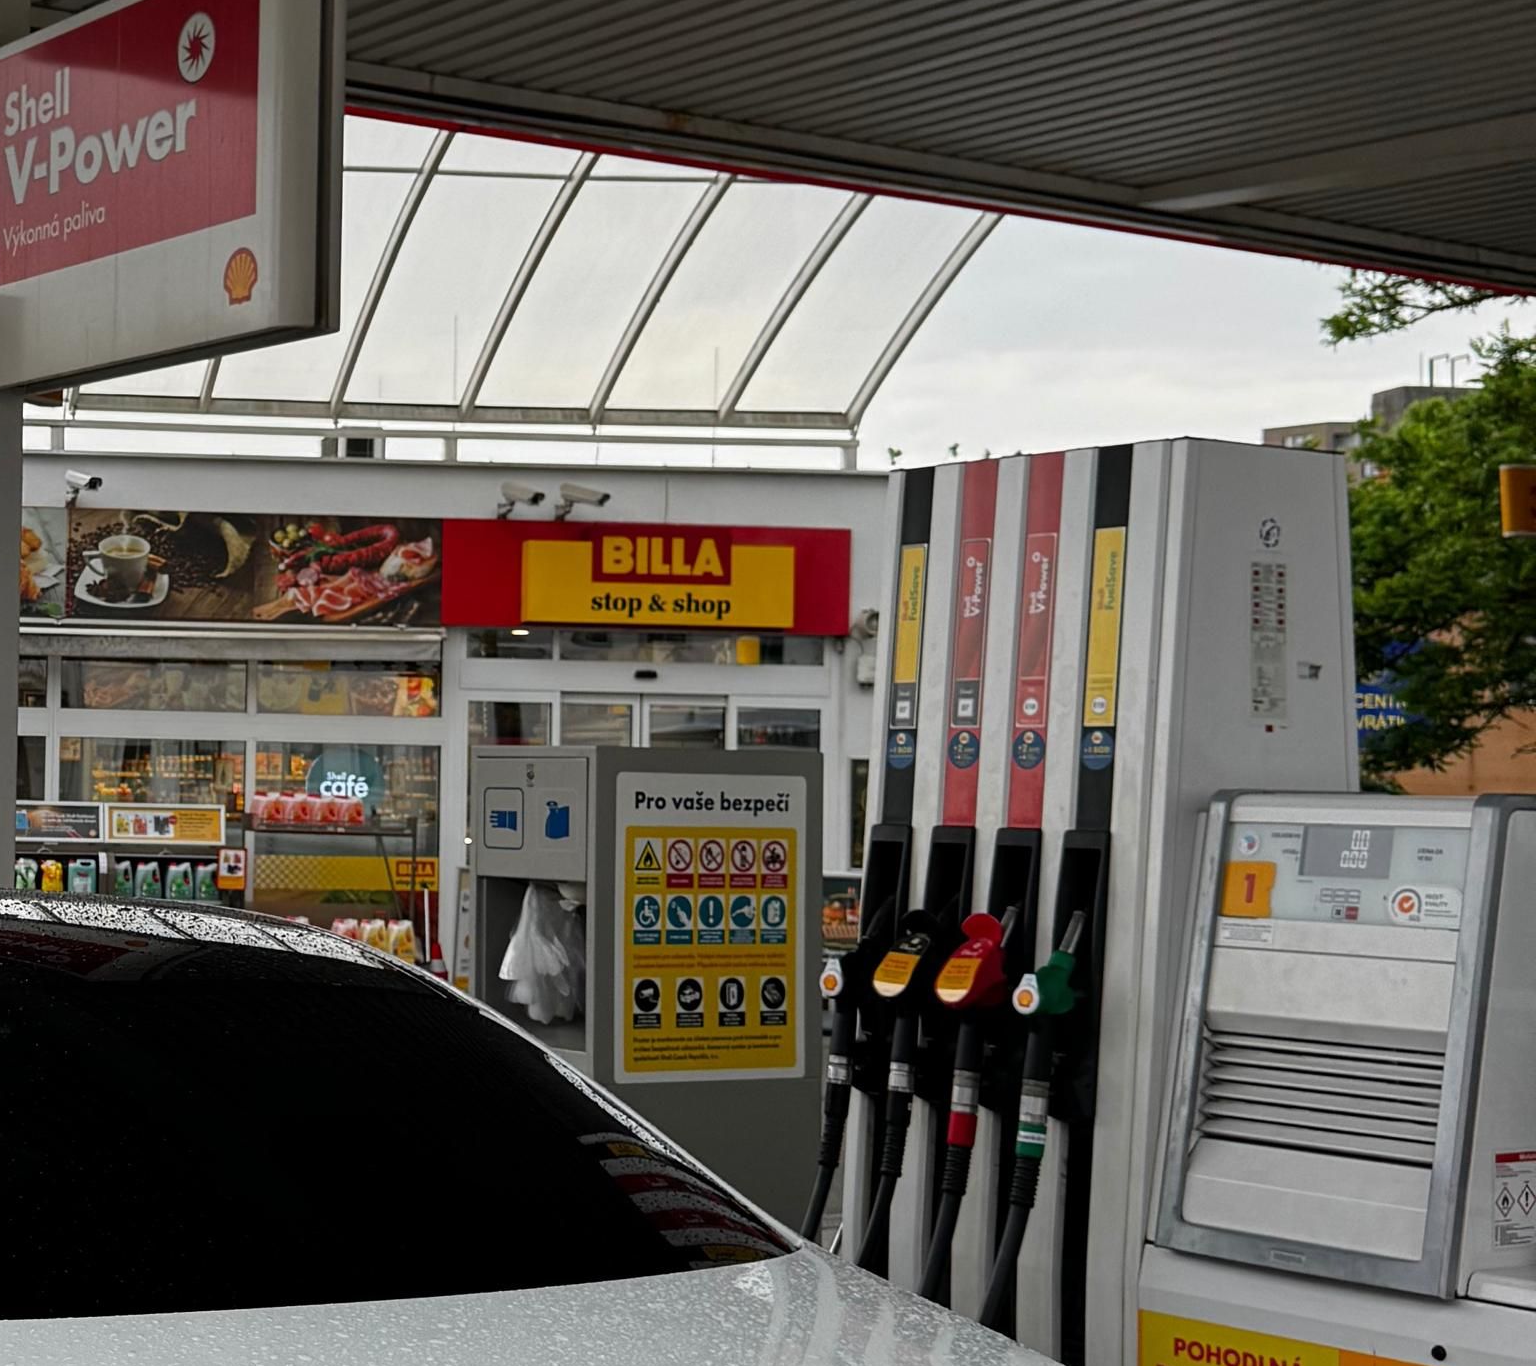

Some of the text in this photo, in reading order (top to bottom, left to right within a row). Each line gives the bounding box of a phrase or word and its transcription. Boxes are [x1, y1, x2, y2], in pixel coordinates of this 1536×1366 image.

[3, 66, 70, 136] Shell
[4, 99, 196, 205] V-Power
[3, 201, 105, 256] Výkonná paliva
[602, 535, 724, 577] BILLA
[1104, 551, 1118, 610] FuelSave
[591, 592, 731, 620] stop & shop
[969, 561, 984, 617] V-Power
[1035, 556, 1049, 614] V-Power
[320, 774, 369, 798] café
[635, 791, 790, 817] Pro vaše bezpečí
[1244, 873, 1257, 903] 1
